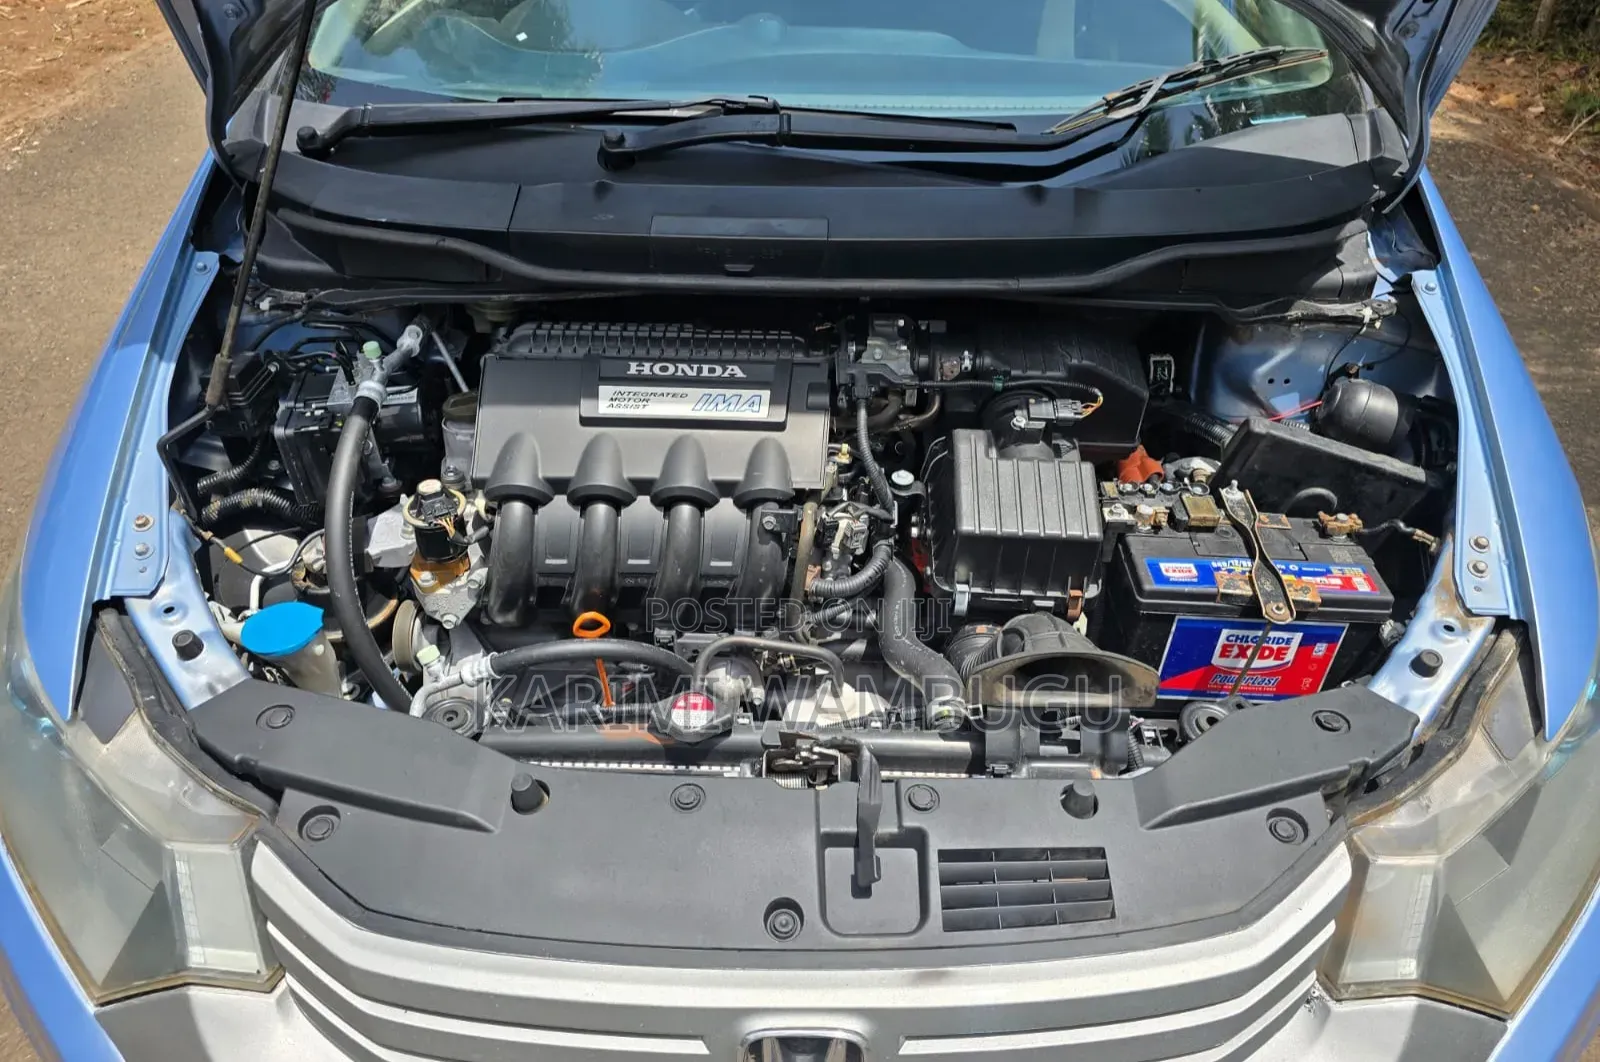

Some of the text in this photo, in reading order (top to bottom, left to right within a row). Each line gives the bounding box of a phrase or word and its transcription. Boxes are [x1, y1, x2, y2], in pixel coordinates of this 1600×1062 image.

[626, 361, 747, 378] HONDA
[612, 391, 689, 399] INTEGRATED
[692, 393, 762, 413] IMA
